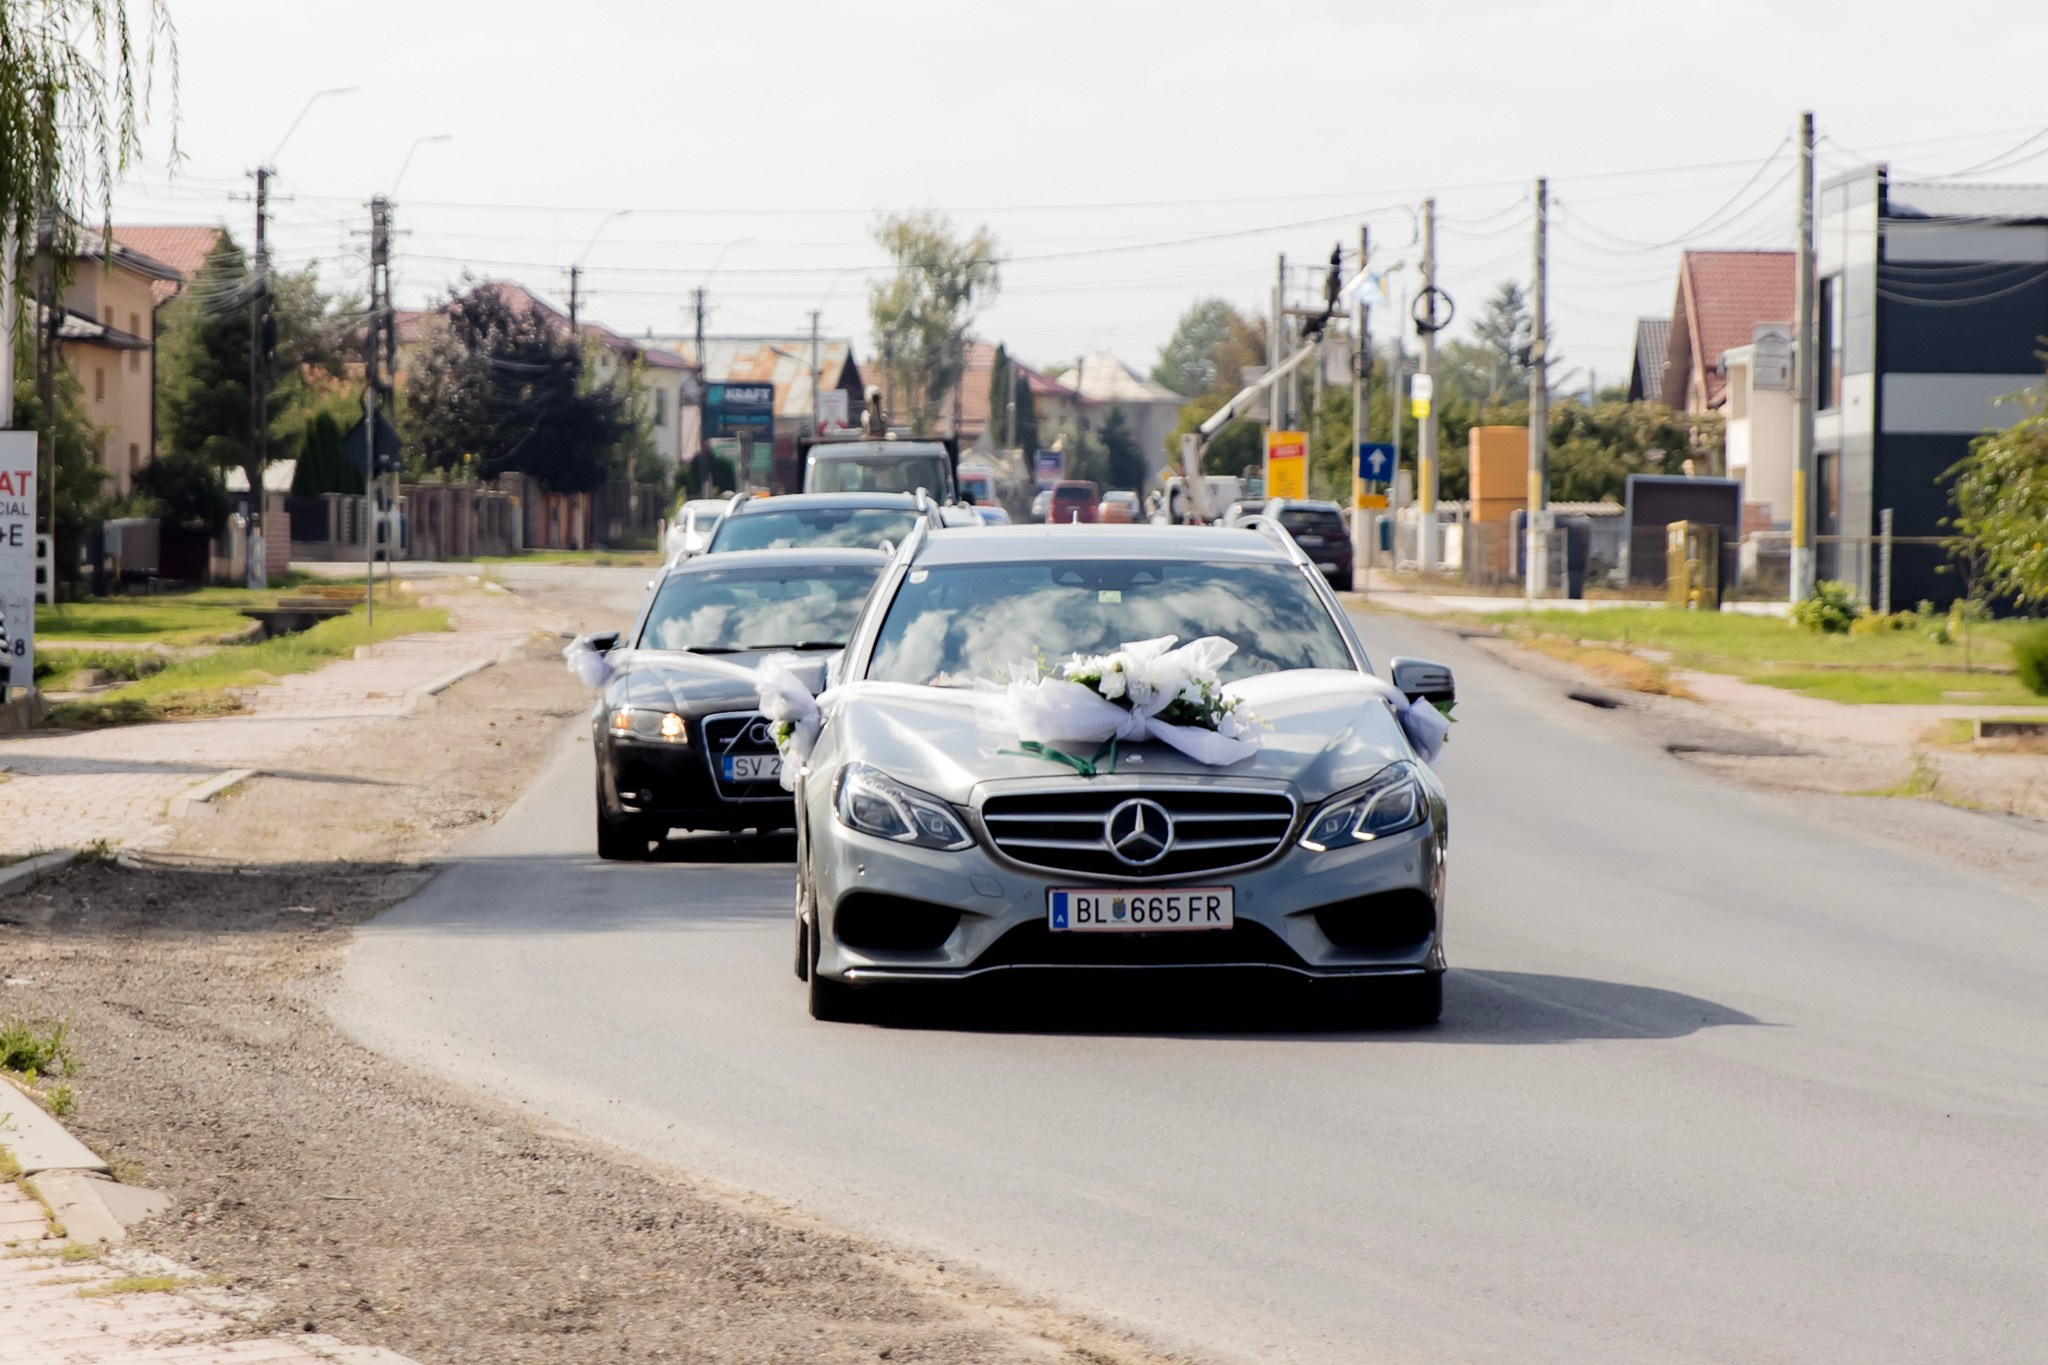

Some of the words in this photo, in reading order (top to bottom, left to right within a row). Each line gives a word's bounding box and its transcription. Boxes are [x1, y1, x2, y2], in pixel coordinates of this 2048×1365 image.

[735, 758, 762, 777] SV
[1056, 914, 1065, 923] A
[1077, 897, 1107, 923] BL
